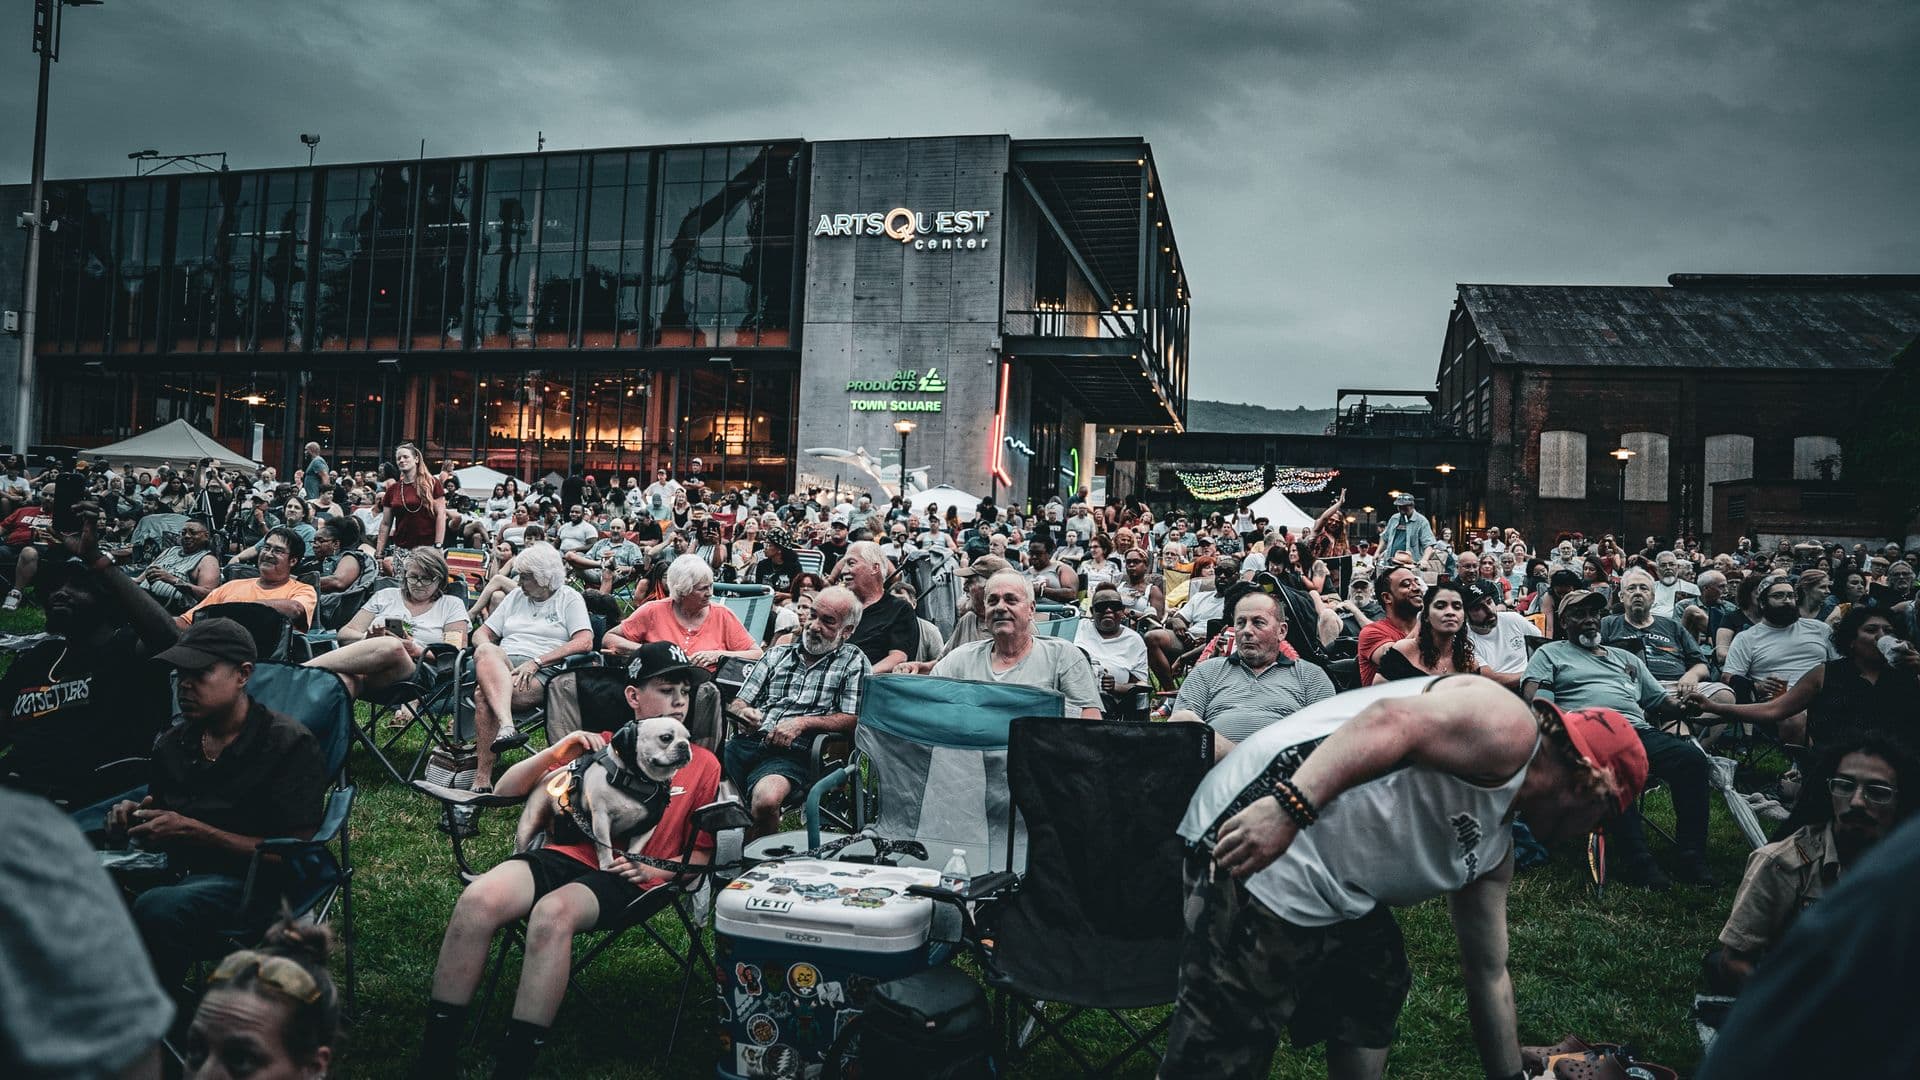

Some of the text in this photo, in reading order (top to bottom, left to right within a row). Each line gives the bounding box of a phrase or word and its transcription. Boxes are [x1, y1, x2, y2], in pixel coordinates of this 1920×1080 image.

[814, 207, 990, 243] ARTSQUEST
[915, 236, 989, 250] center
[893, 369, 917, 380] AIR
[846, 380, 917, 392] PRODUCTS
[851, 400, 942, 412] TOWN SQUARE
[668, 645, 688, 663] NY
[752, 897, 788, 909] YETI
